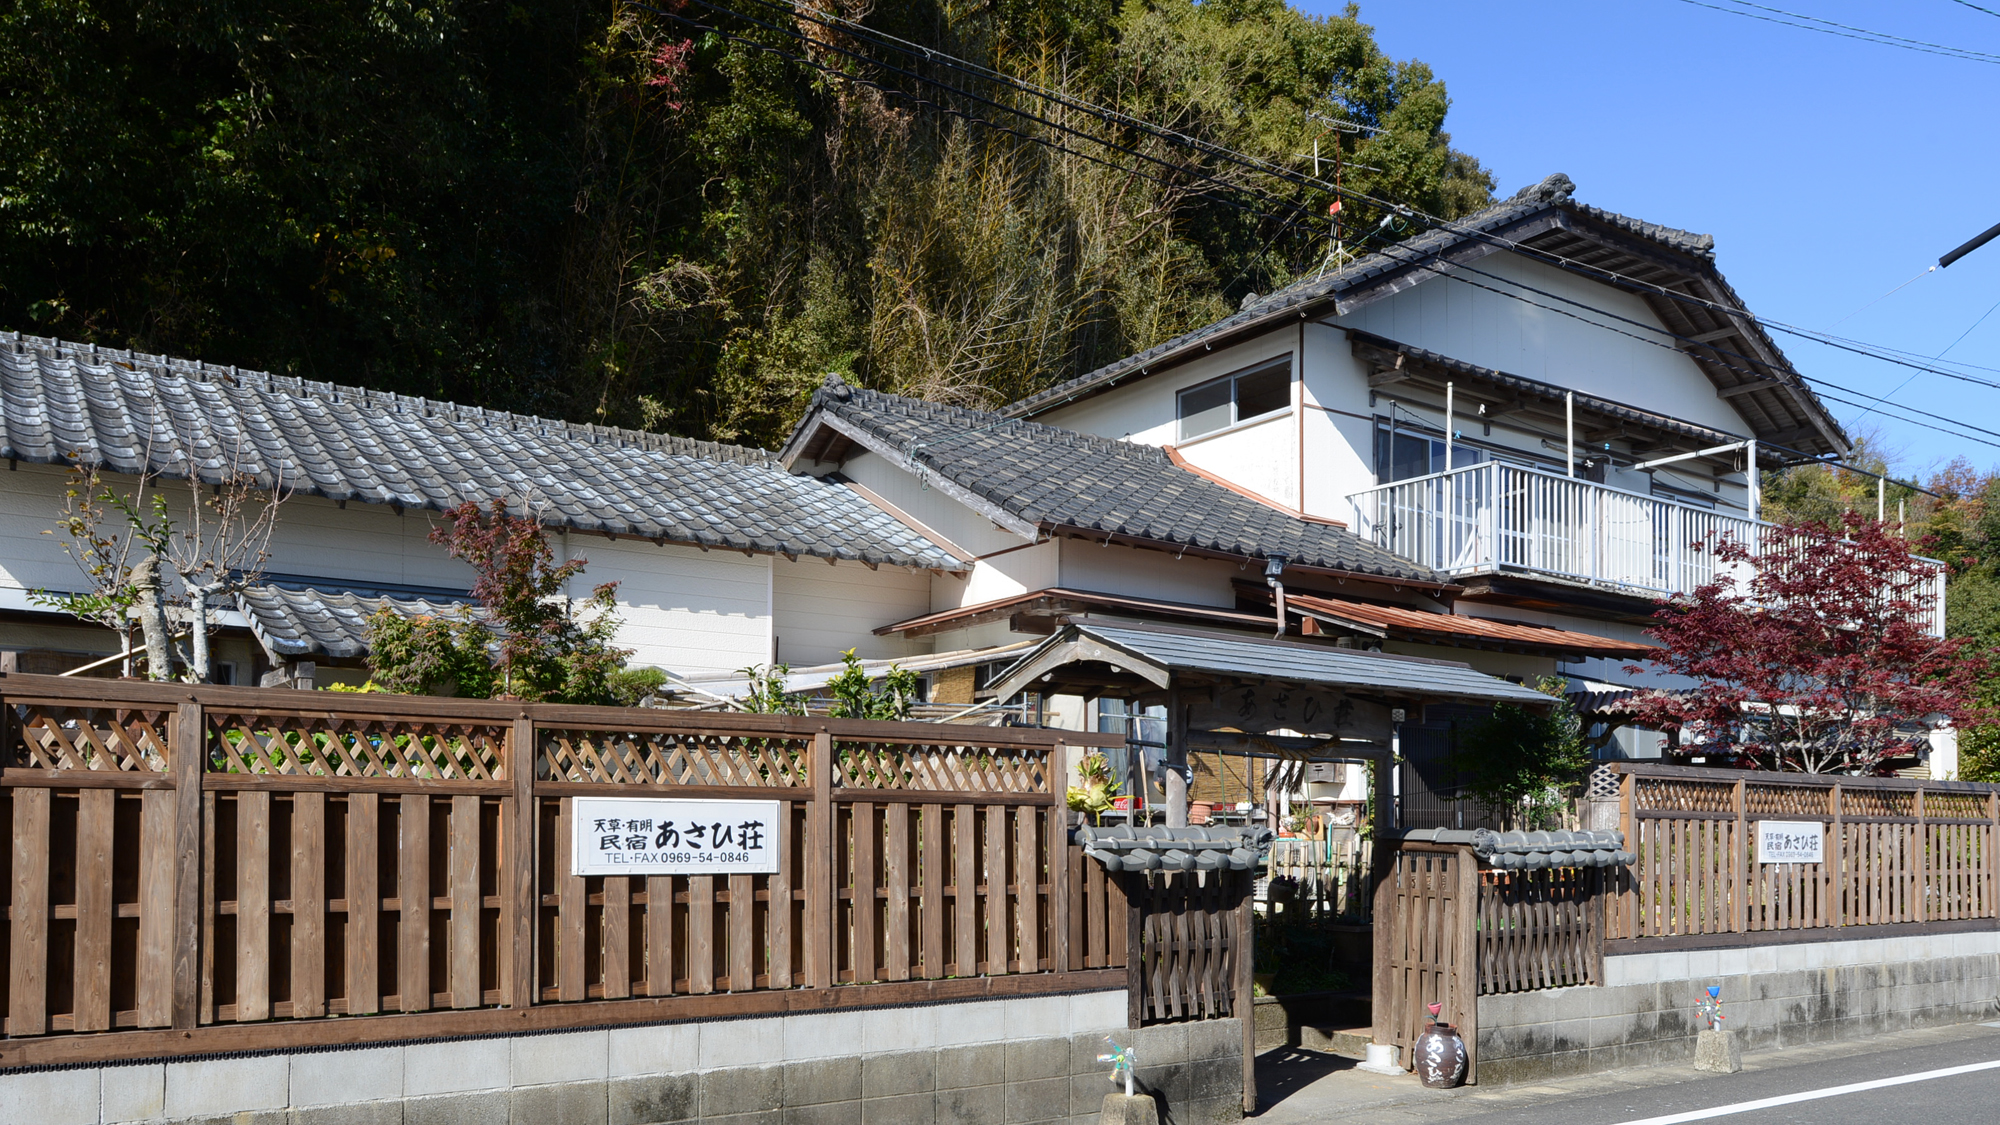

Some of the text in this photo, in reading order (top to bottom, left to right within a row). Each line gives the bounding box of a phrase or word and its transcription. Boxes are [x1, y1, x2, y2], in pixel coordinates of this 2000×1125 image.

[1237, 688, 1355, 728] あさひ荘
[599, 834, 648, 850] 民宿
[655, 820, 764, 850] あさひ荘
[1784, 834, 1818, 850] あさひ荘
[660, 852, 750, 863] 0969-54-0846
